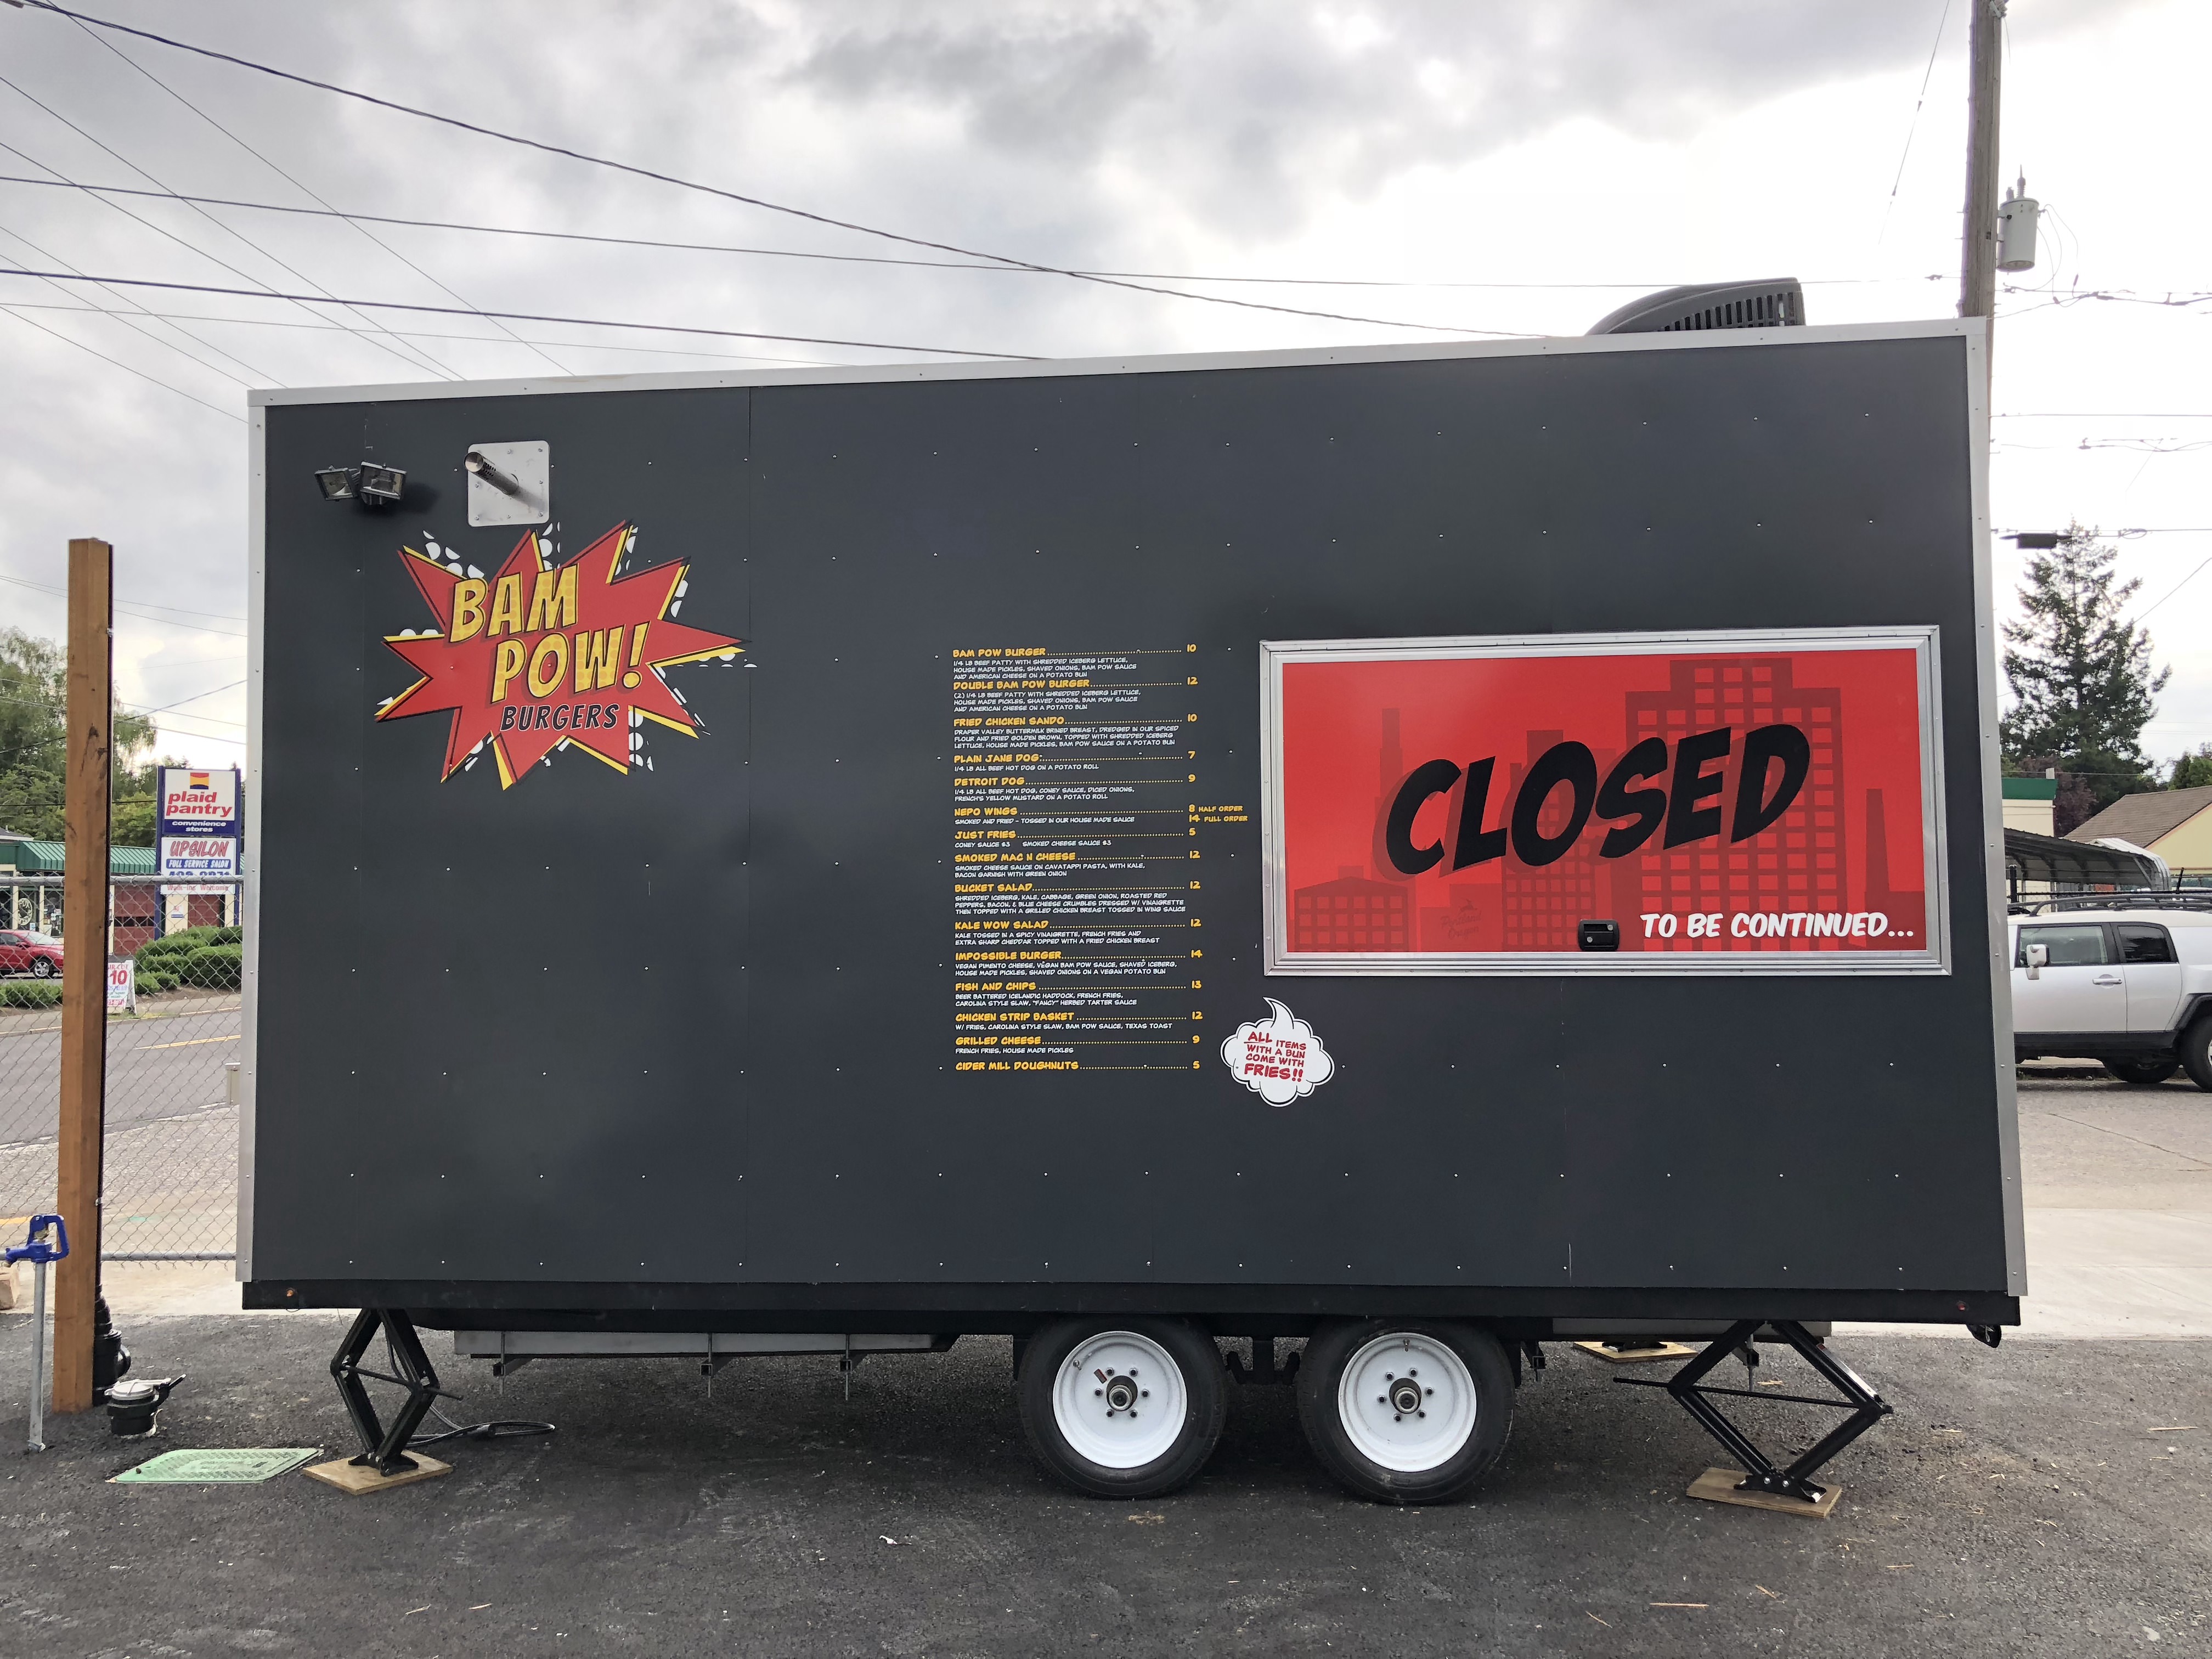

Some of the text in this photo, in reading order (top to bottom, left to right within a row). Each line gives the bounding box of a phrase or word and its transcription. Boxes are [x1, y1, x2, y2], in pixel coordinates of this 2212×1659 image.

[449, 563, 579, 642] BAM
[952, 644, 1197, 658] BAM POW BURGER 10
[490, 620, 651, 704] POW!
[953, 676, 1198, 690] DOUBLE BAM POW BURGER 12
[500, 703, 619, 731] BURGERS
[953, 713, 1198, 727] FRIED CHICKEN SANDO 10
[953, 751, 1195, 764] PLAIN JANE DOG 7
[954, 774, 1196, 787] DETROIT DOG 9
[168, 791, 217, 804] plaid
[1385, 724, 1810, 875] CLOSED
[166, 804, 233, 817] pantry
[954, 808, 981, 817] NEPO
[984, 807, 1018, 816] WINGS
[1188, 804, 1195, 812] 8
[1189, 814, 1201, 822] 14
[955, 827, 1196, 839] JUST FRIES 5
[170, 840, 229, 857] UPSILON
[954, 850, 1200, 862] SMOKED MAC N CHEESE 12
[168, 860, 229, 868] FULL SERVICE SALON
[955, 881, 1201, 893] BUCKET SALAD 12
[955, 918, 1201, 930] KALE WOW SALAD 12
[1640, 912, 1914, 938] TO BE CONTINUED...
[955, 949, 1203, 961] IMPOSSIBLE BURGER 14
[955, 980, 1202, 991] FISH AND CHIPS 13
[955, 1011, 1203, 1022] CHICKEN STRIP BASKET 12
[955, 1035, 1200, 1046] GRILLED CHEESE 9
[1248, 1031, 1306, 1050] ALL ITEMS
[1247, 1045, 1272, 1054] WITH
[1286, 1049, 1305, 1059] BUN
[955, 1060, 1200, 1070] CIDER MILL DOUGHNUTS 5
[1245, 1053, 1304, 1067] COME WITH
[1244, 1063, 1304, 1082] FRIES!!
